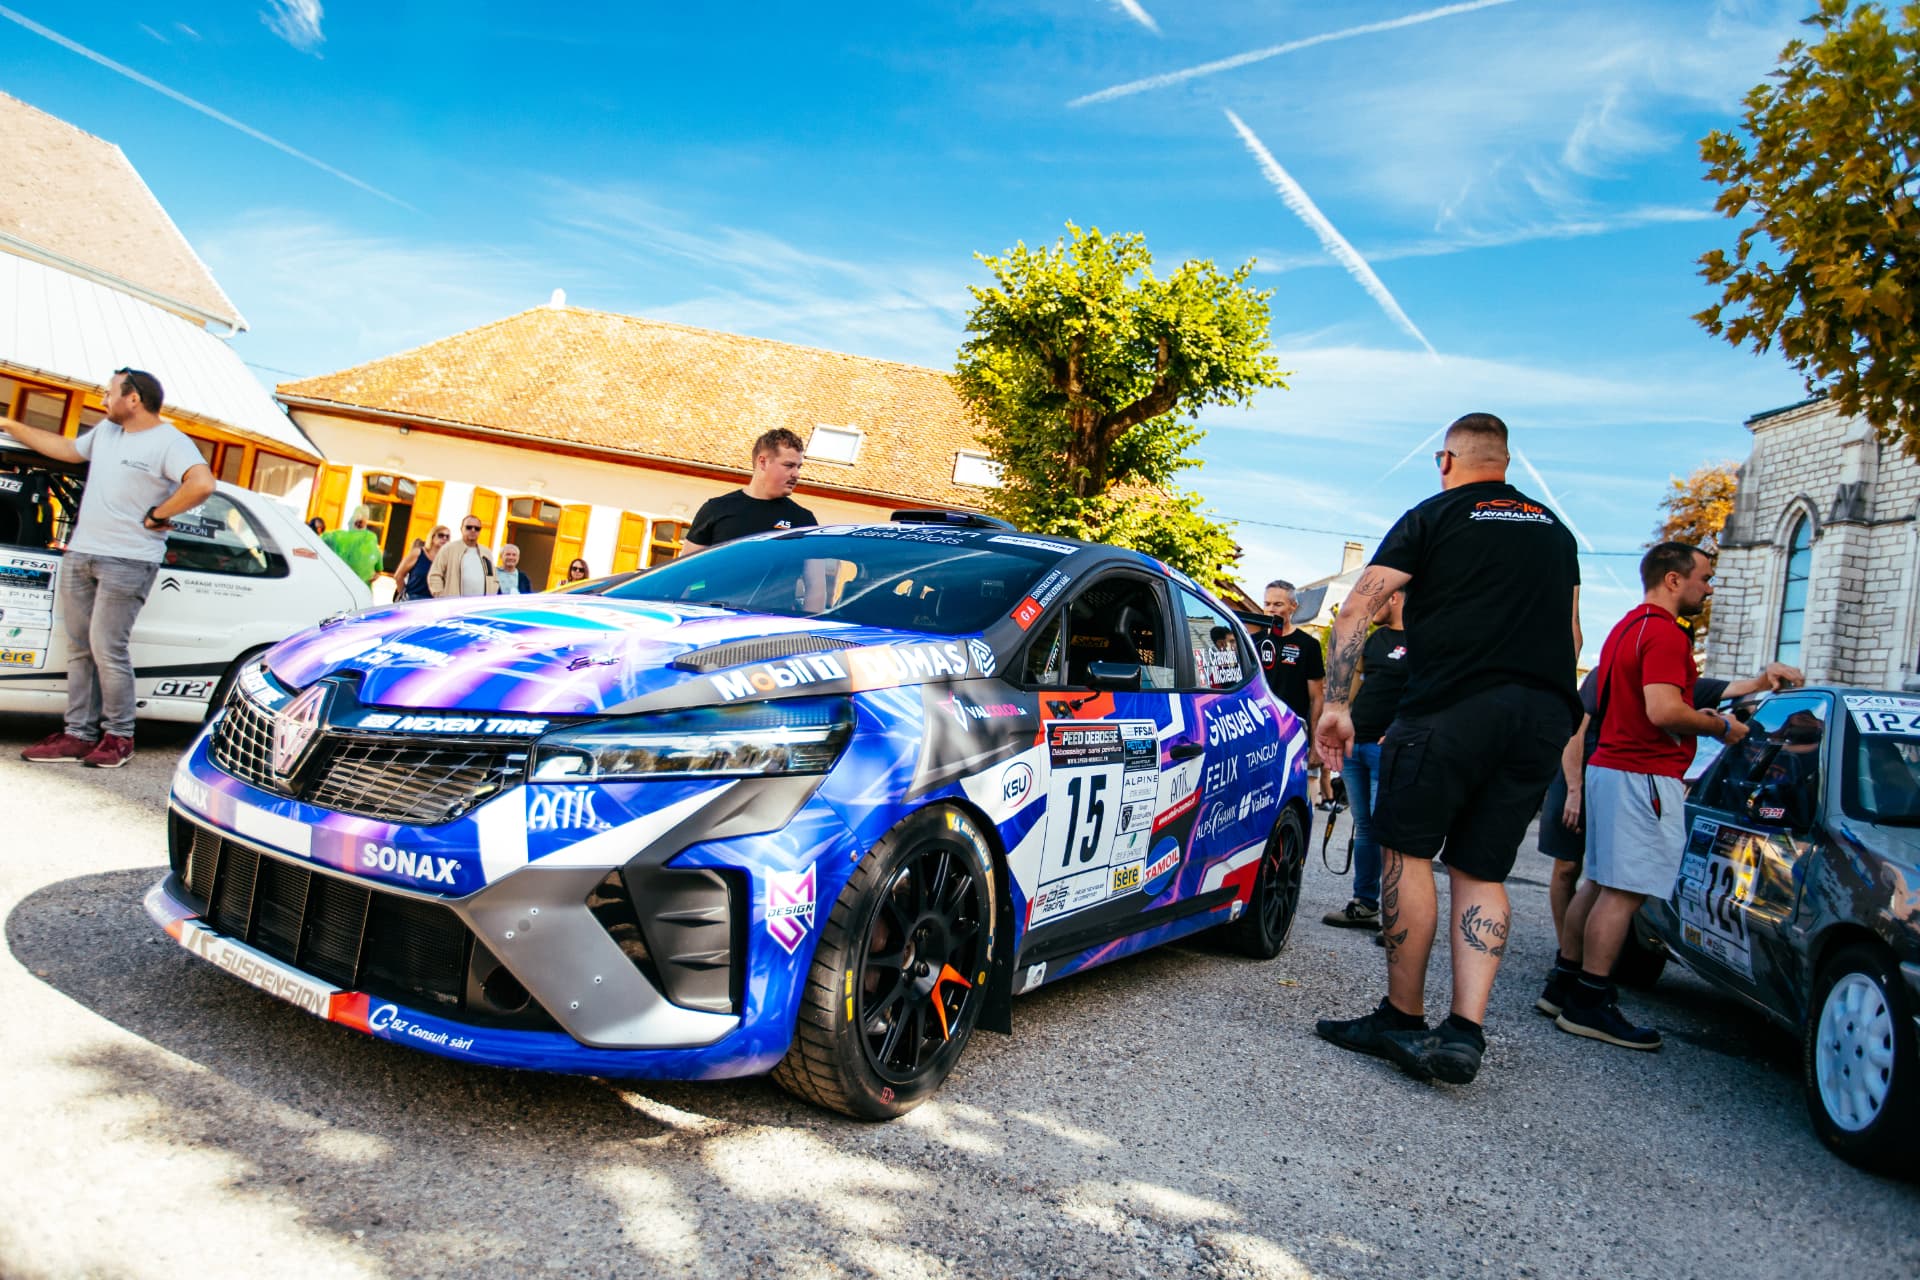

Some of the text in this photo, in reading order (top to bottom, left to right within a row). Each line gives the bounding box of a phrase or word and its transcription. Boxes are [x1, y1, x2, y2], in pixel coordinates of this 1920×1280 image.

[11, 558, 48, 569] FFSA
[855, 644, 969, 684] DUMAS
[709, 651, 848, 701] Mobil 1
[396, 714, 549, 735] NEXEN TIRE
[1133, 726, 1153, 738] FFSA
[1051, 727, 1119, 746] SPEED DEBOSSE
[1205, 754, 1239, 794] FELIX
[1245, 741, 1279, 769] TANGUY
[1003, 775, 1027, 801] KSU
[1124, 774, 1158, 787] ALPINE
[1062, 774, 1107, 868] 15
[363, 843, 460, 885] SONAX
[1145, 849, 1180, 880] TAMOIL
[1113, 866, 1138, 889] isère
[768, 904, 815, 917] DESIGN
[408, 1023, 449, 1045] Consult
